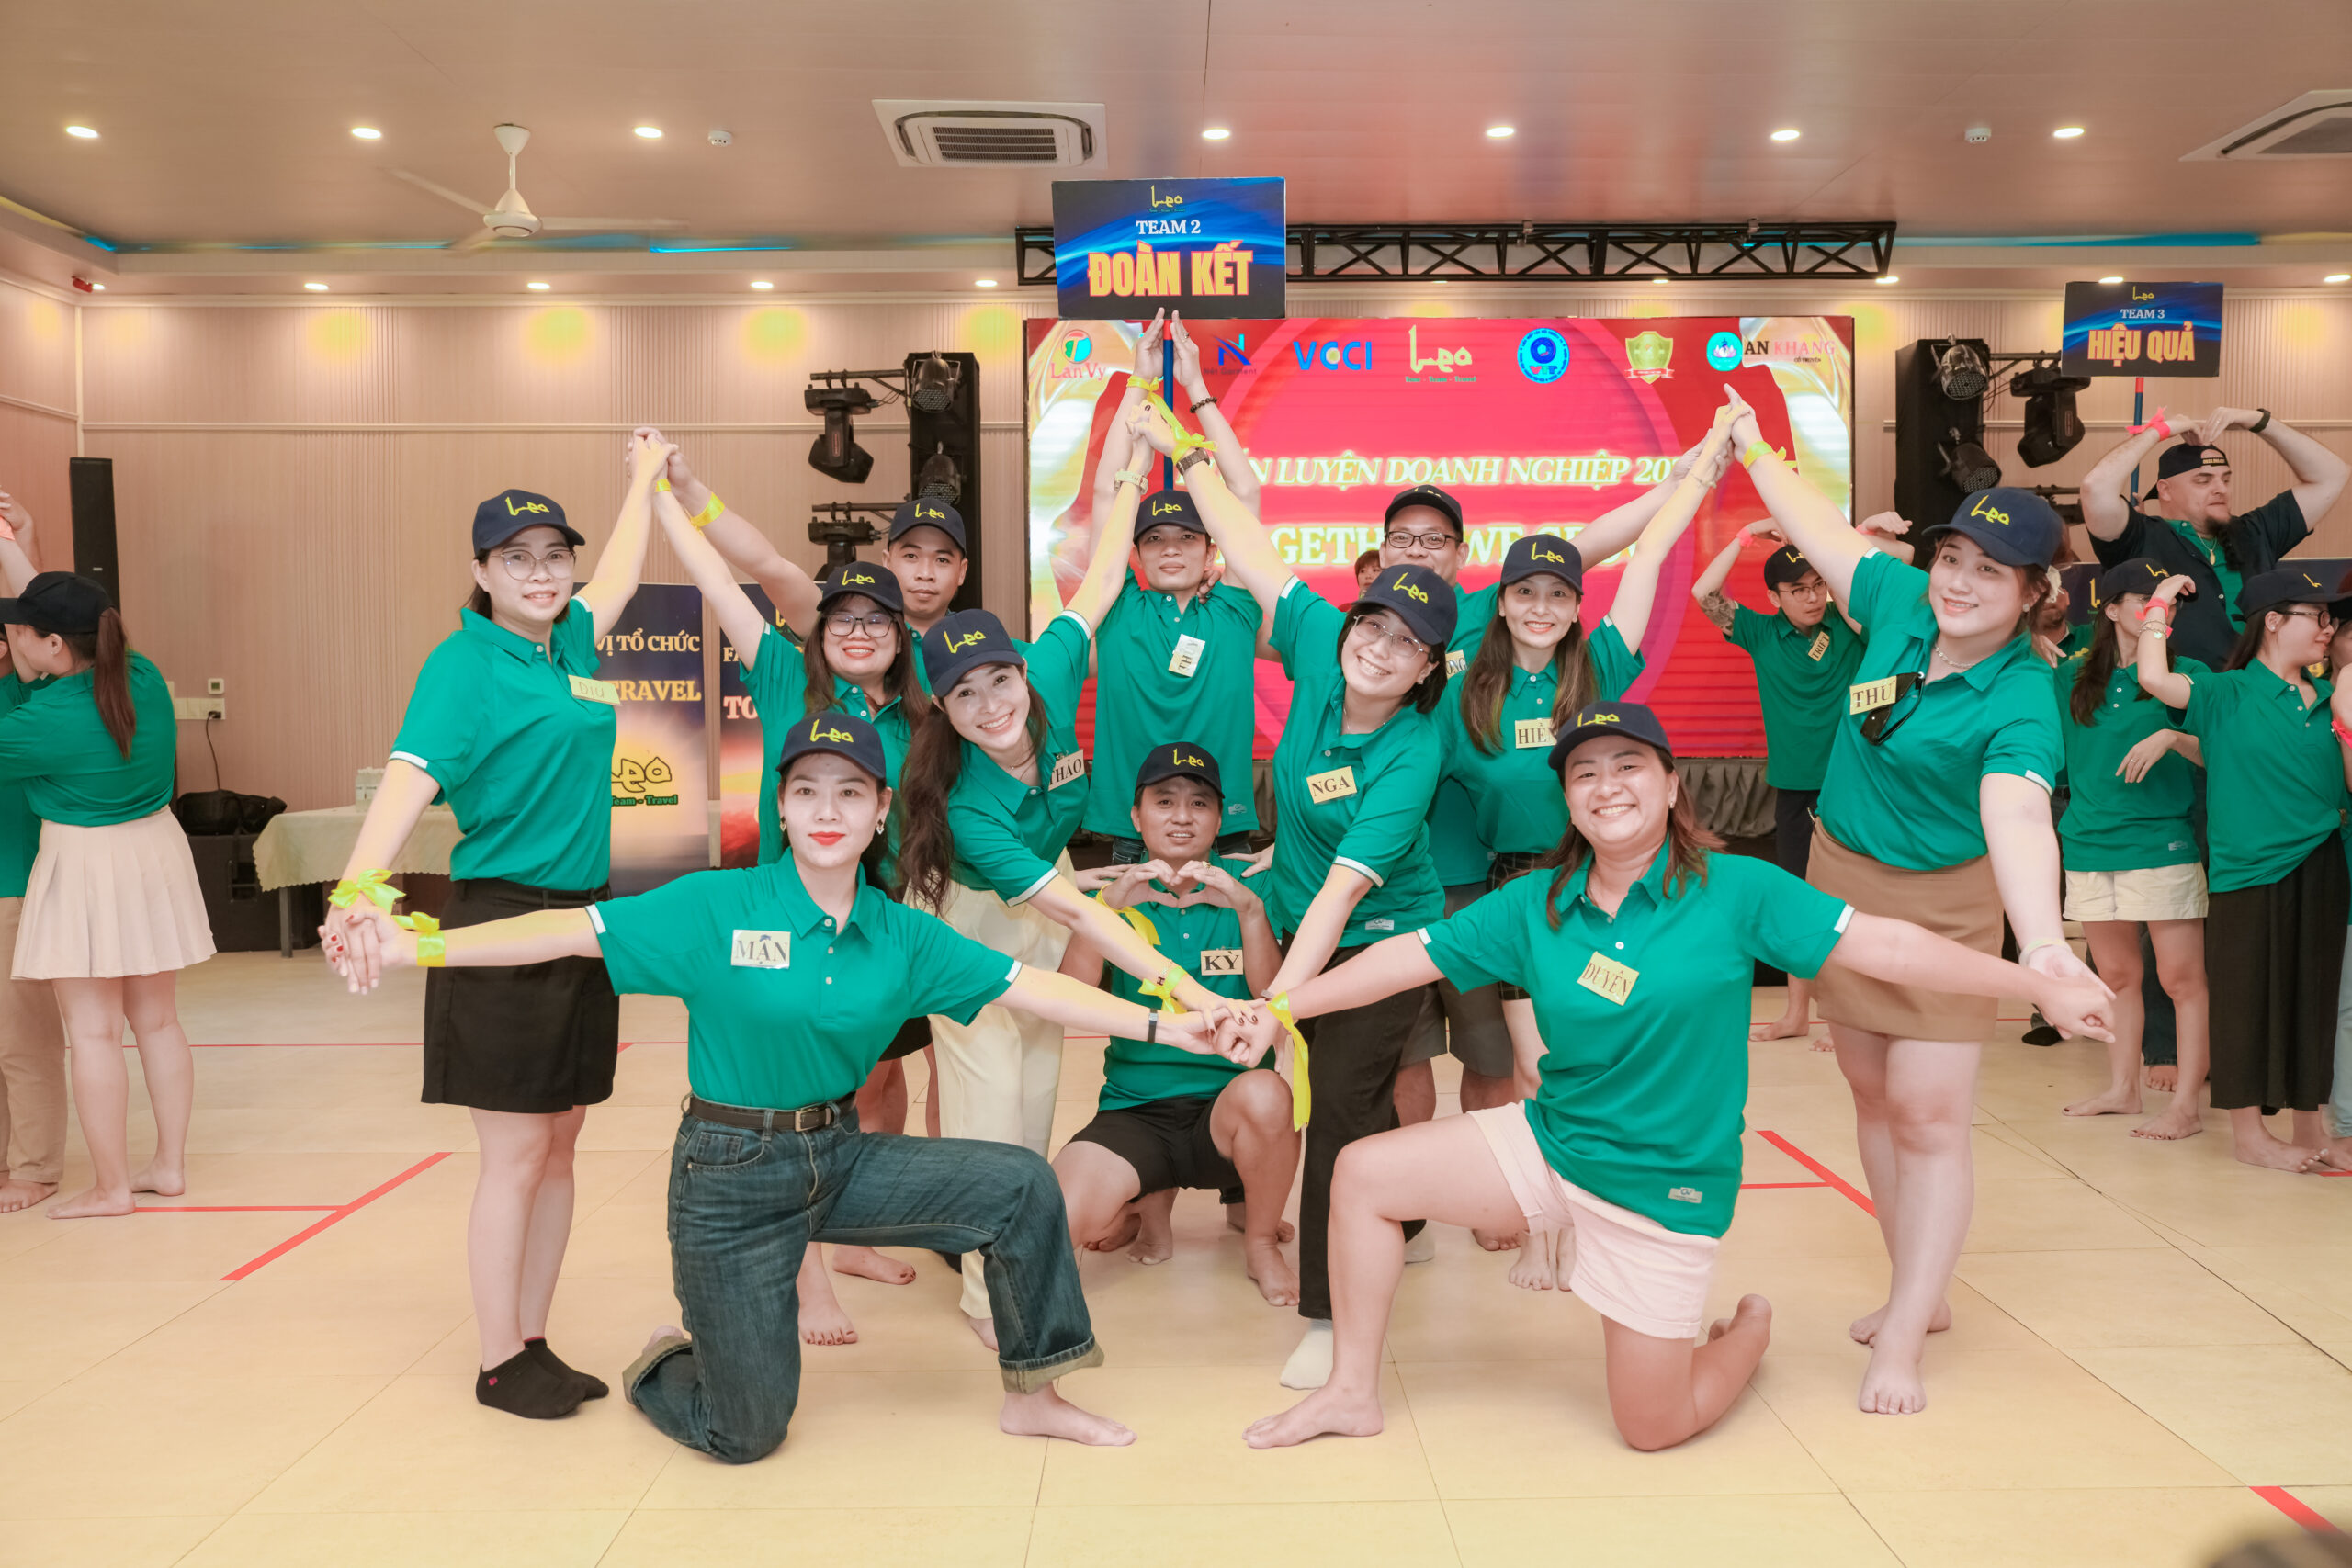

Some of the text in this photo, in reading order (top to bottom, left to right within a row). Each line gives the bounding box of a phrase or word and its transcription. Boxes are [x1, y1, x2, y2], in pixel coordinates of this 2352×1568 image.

[1136, 220, 1202, 235] TEAM 2
[1087, 240, 1254, 297] ĐOÀN KẾT
[2120, 309, 2165, 320] TEAM 3
[1744, 341, 1837, 355] AN KHANG
[2087, 321, 2196, 367] HIỆU QUẢ
[1292, 341, 1373, 371] VCCI
[1050, 362, 1107, 381] Lan Vy
[1275, 449, 1382, 491] LUYỆN
[1384, 457, 1504, 484] DOANH
[1505, 449, 1631, 491] NGHIỆP
[1633, 457, 1680, 484] 20
[616, 628, 645, 653] TỔ
[647, 630, 701, 653] CHỨC
[1310, 777, 1351, 797] NGA
[644, 795, 678, 806] Travel
[734, 933, 787, 965] MẬN
[1204, 950, 1240, 971] KỲ
[1581, 961, 1632, 997] DUYÊN
